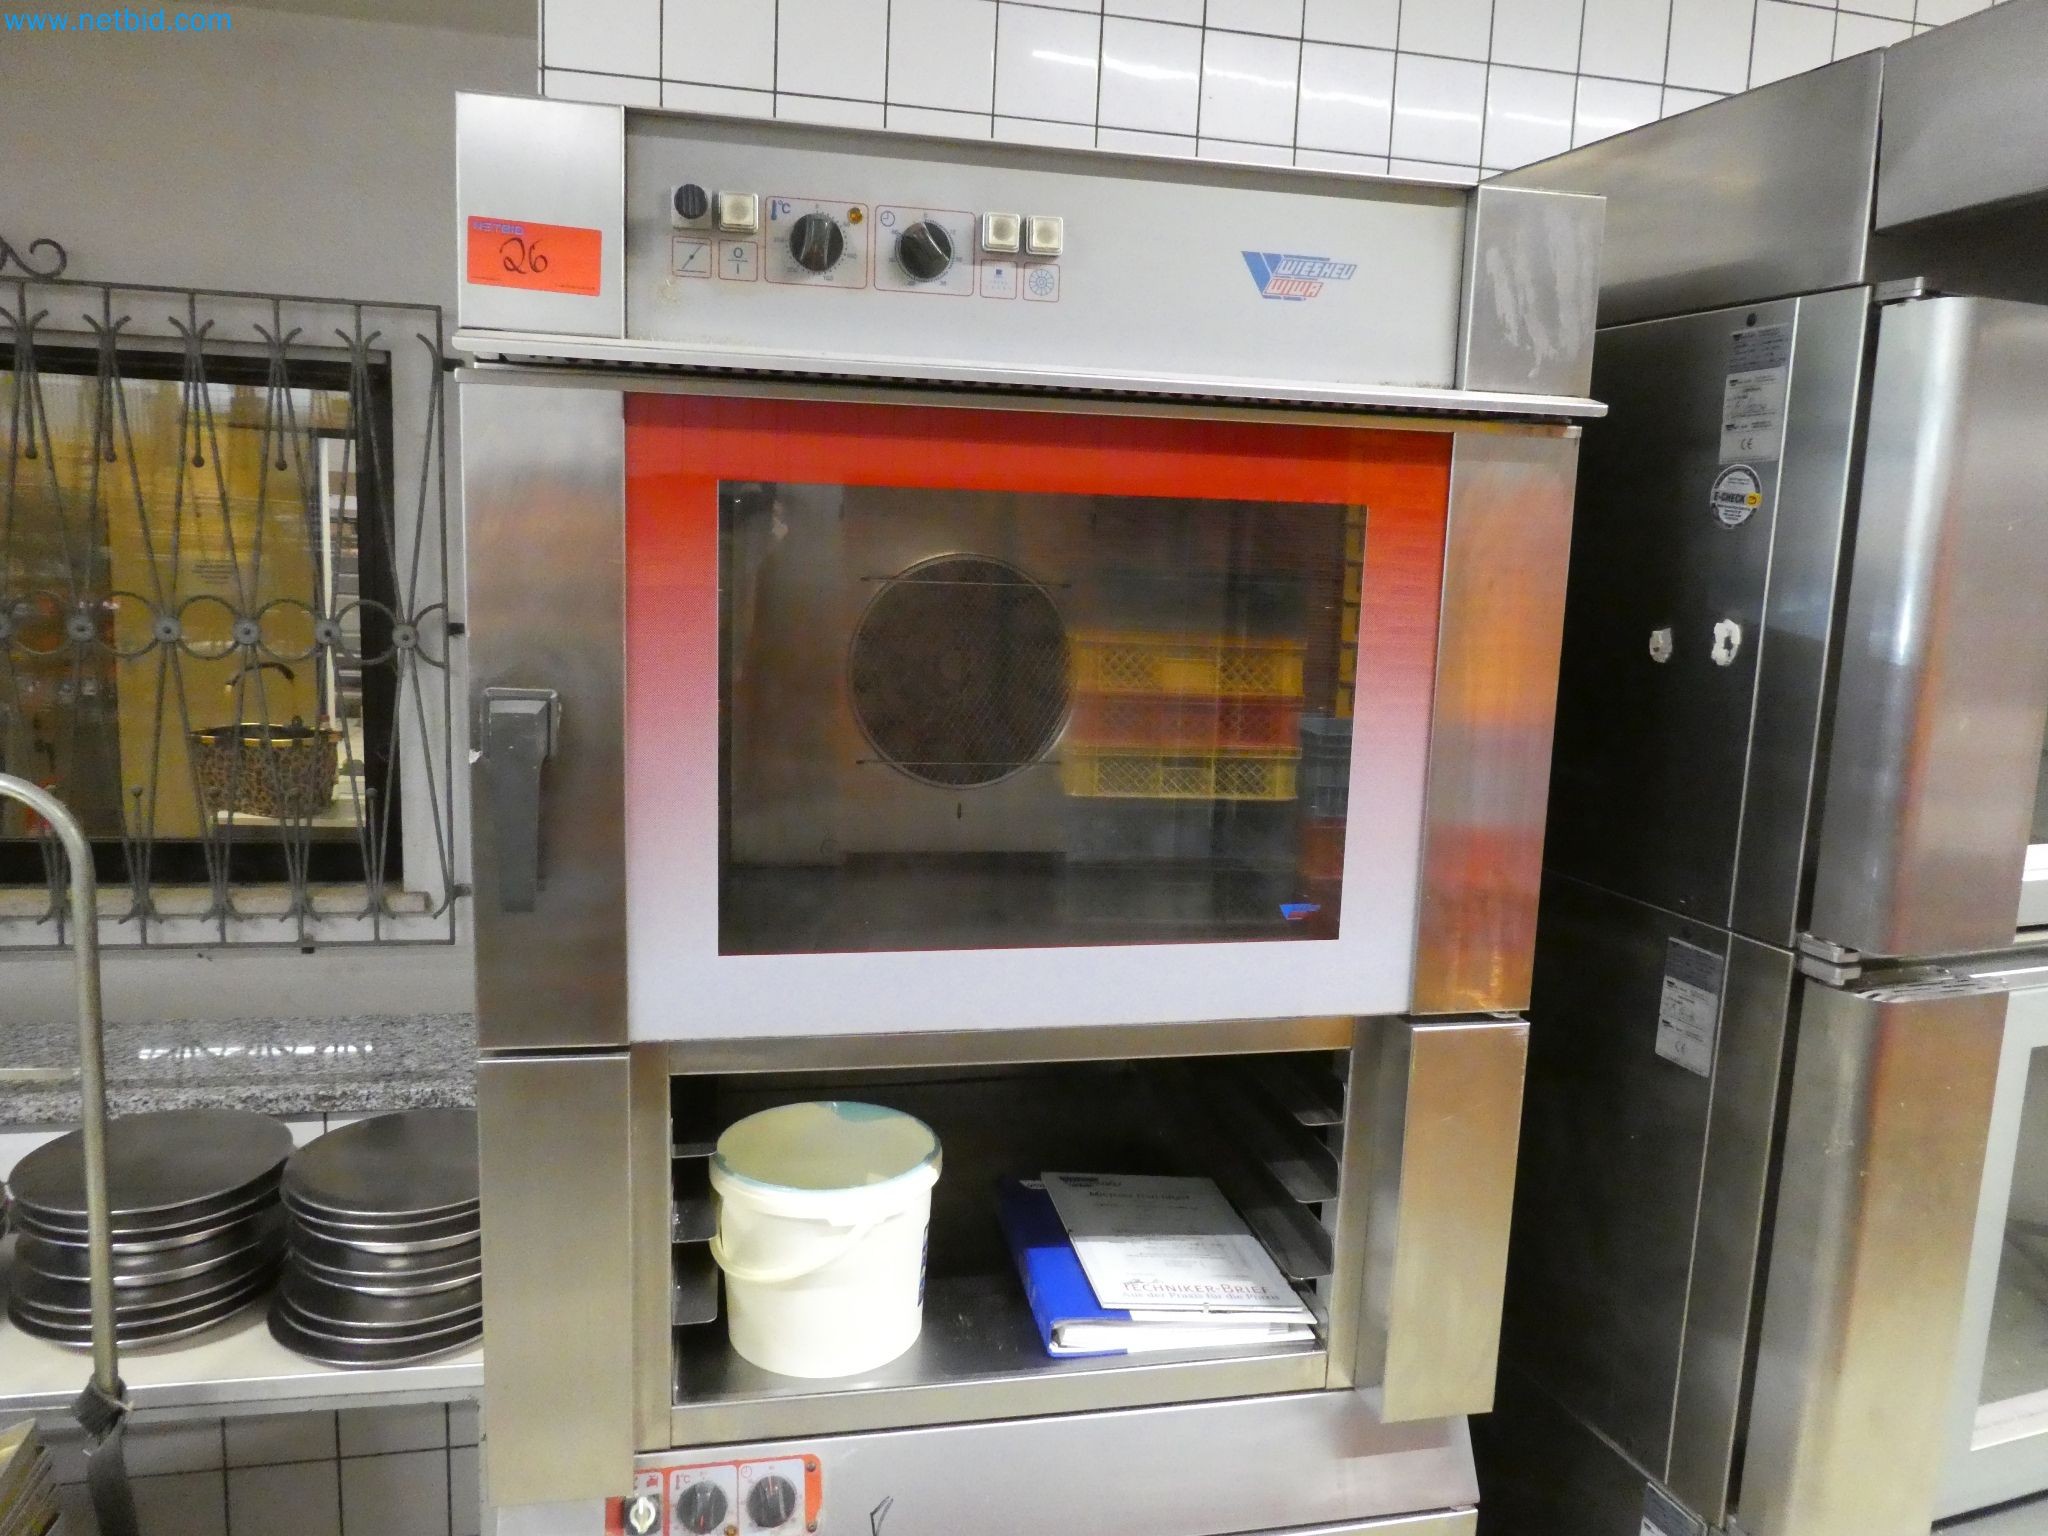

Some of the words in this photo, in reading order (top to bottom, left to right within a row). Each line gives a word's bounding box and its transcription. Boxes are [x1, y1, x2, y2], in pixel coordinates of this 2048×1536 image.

[473, 222, 523, 235] NETBID
[499, 237, 548, 275] 26
[1275, 259, 1357, 280] WIESHEU
[1264, 279, 1323, 298] WIWA
